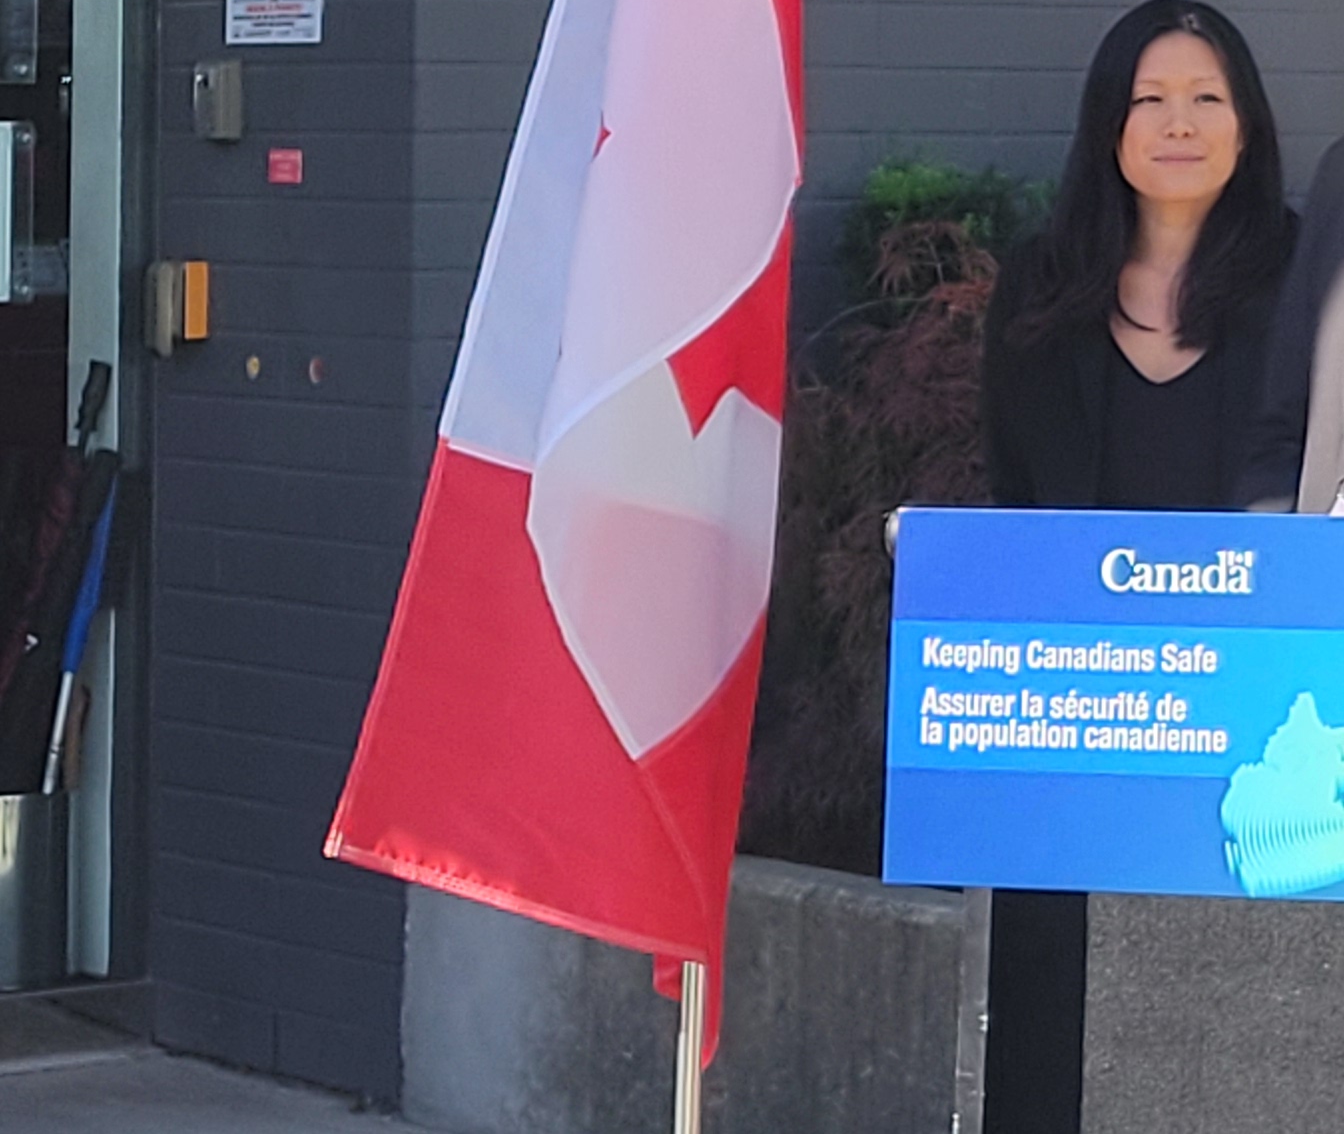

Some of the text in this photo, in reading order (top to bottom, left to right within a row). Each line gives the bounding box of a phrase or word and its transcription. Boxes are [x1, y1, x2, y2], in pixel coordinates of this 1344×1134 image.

[1100, 548, 1253, 594] Canada
[922, 637, 1218, 675] Keeping Canadians Safe
[920, 686, 1188, 722] Assurer la sécurité de
[920, 715, 1228, 754] la population canadienne
